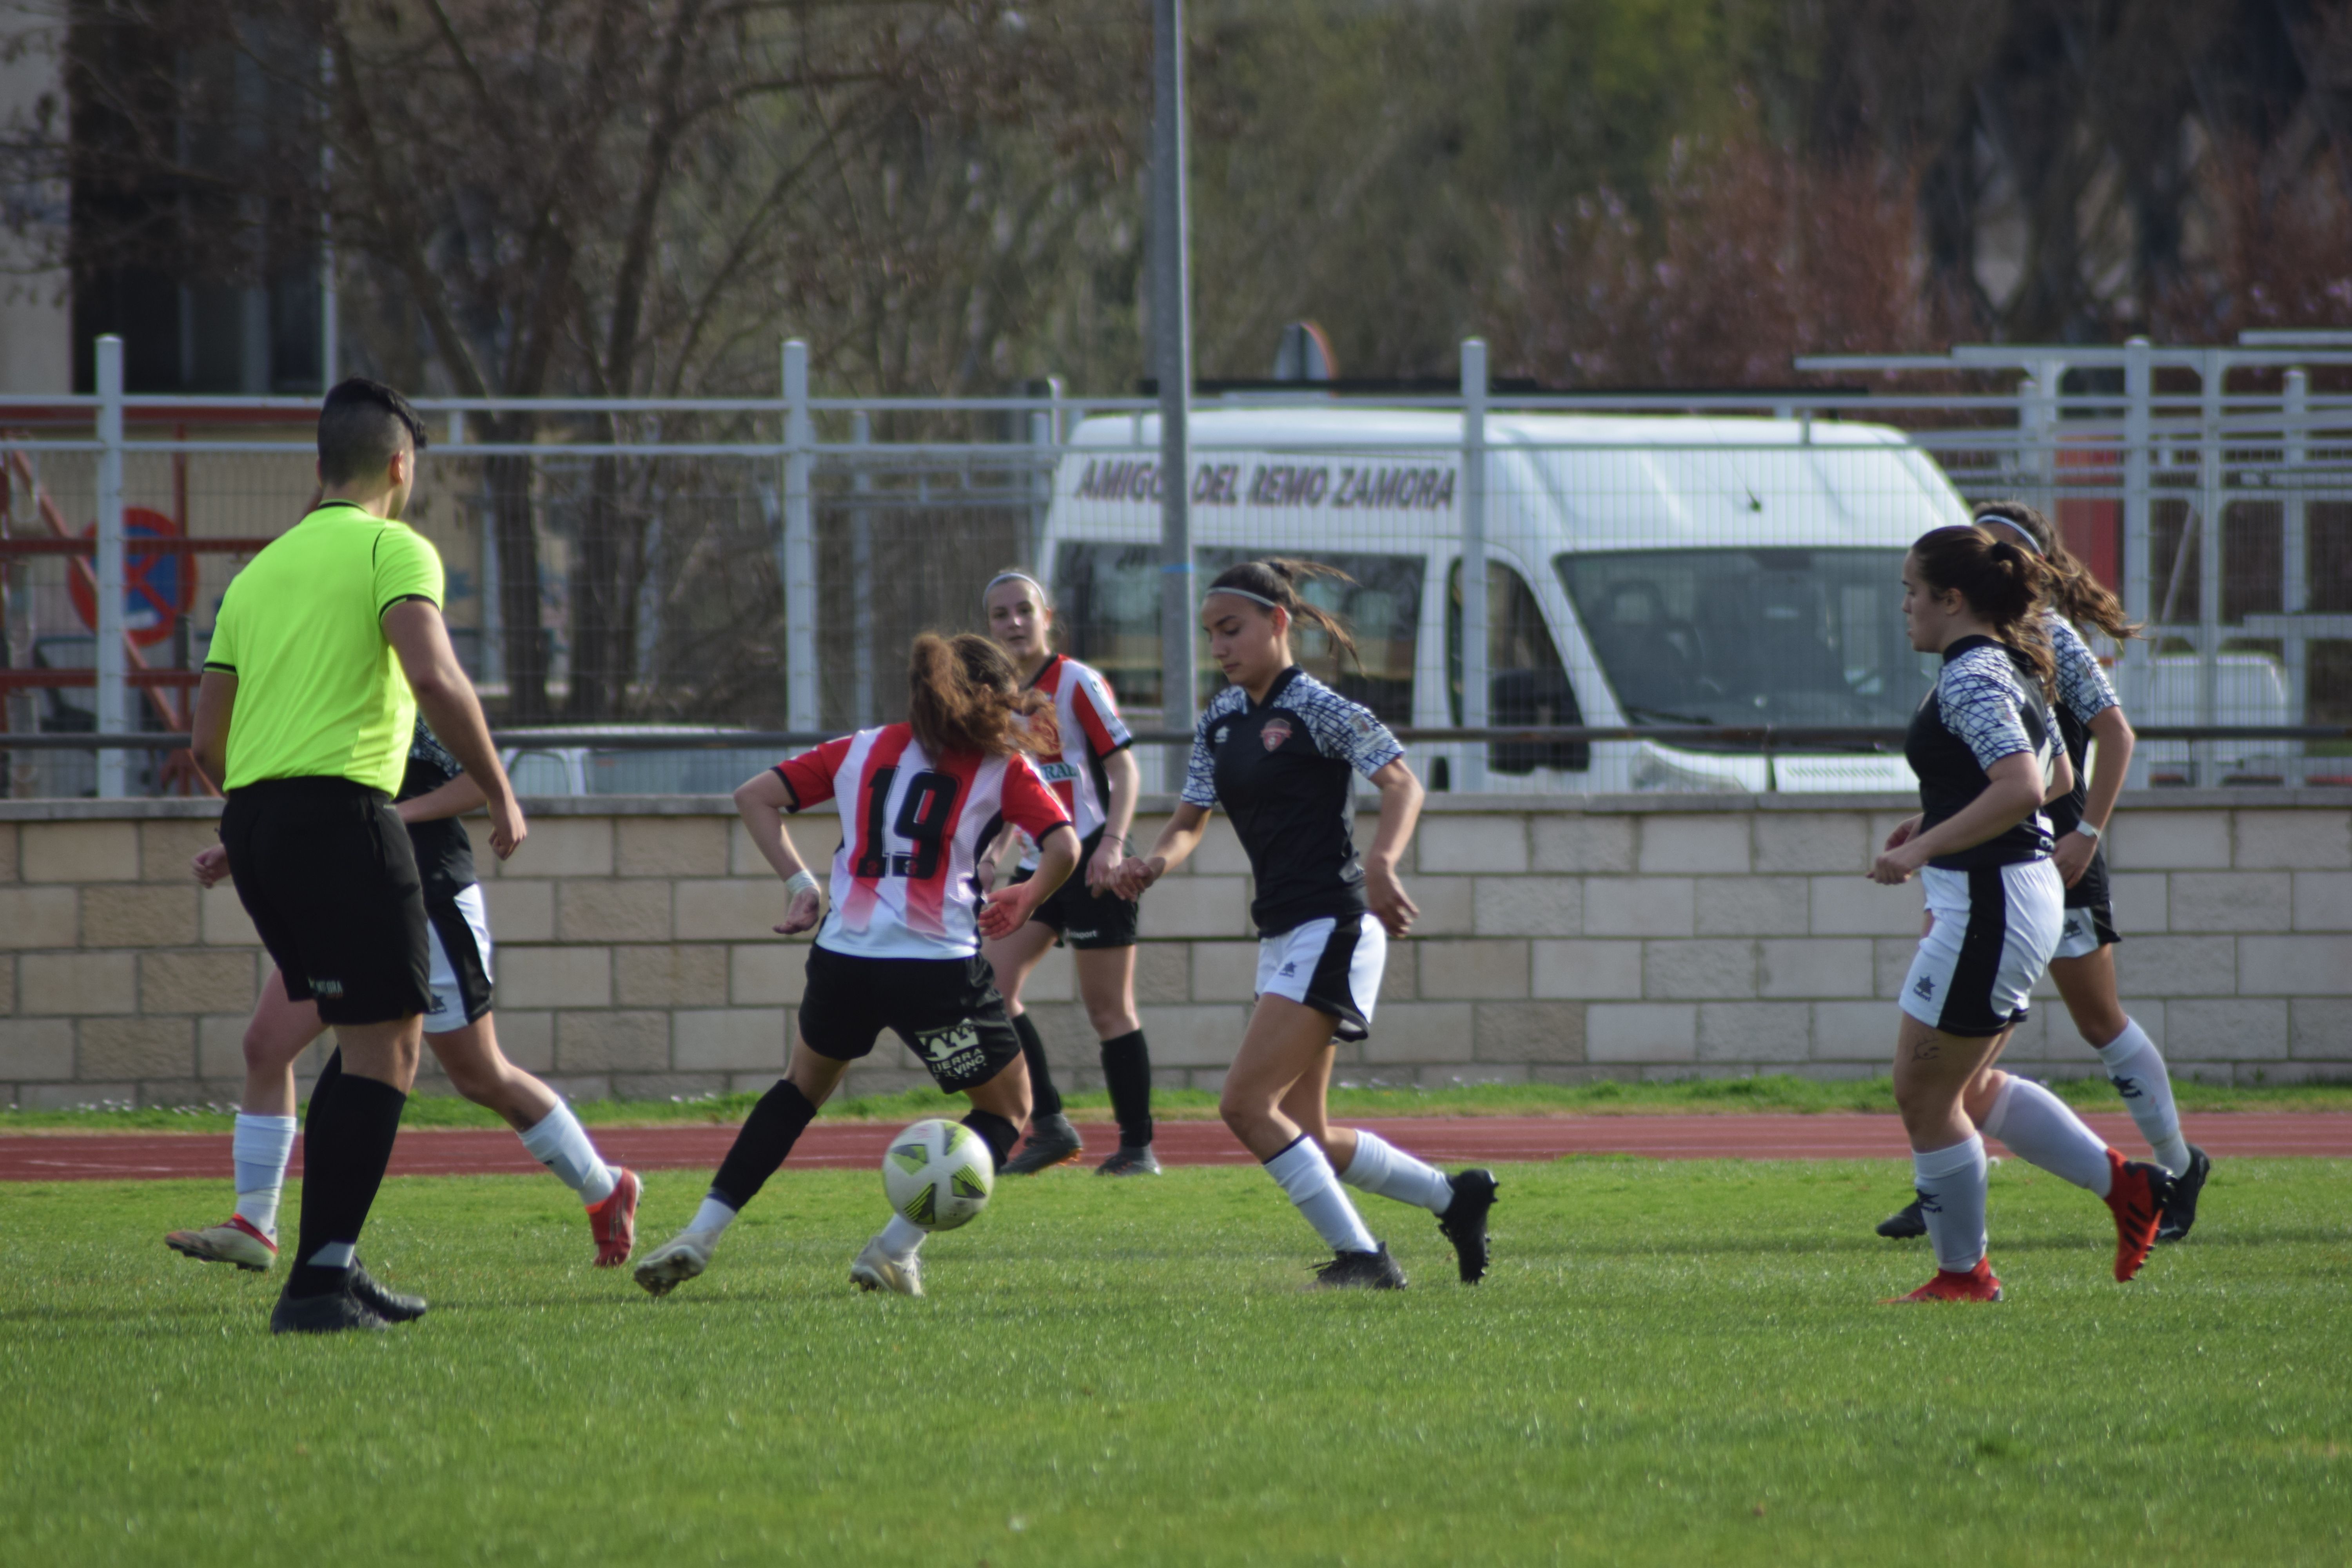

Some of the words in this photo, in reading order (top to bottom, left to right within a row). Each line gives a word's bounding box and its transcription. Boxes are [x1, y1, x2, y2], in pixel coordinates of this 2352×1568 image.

[1073, 459, 1163, 503] AMIGO
[1192, 462, 1239, 505] DEL
[1247, 466, 1328, 506] REMO
[1332, 467, 1455, 509] ZAMORA
[1041, 763, 1077, 780] RAL
[856, 765, 960, 880] 19
[953, 1055, 985, 1074] VINO
